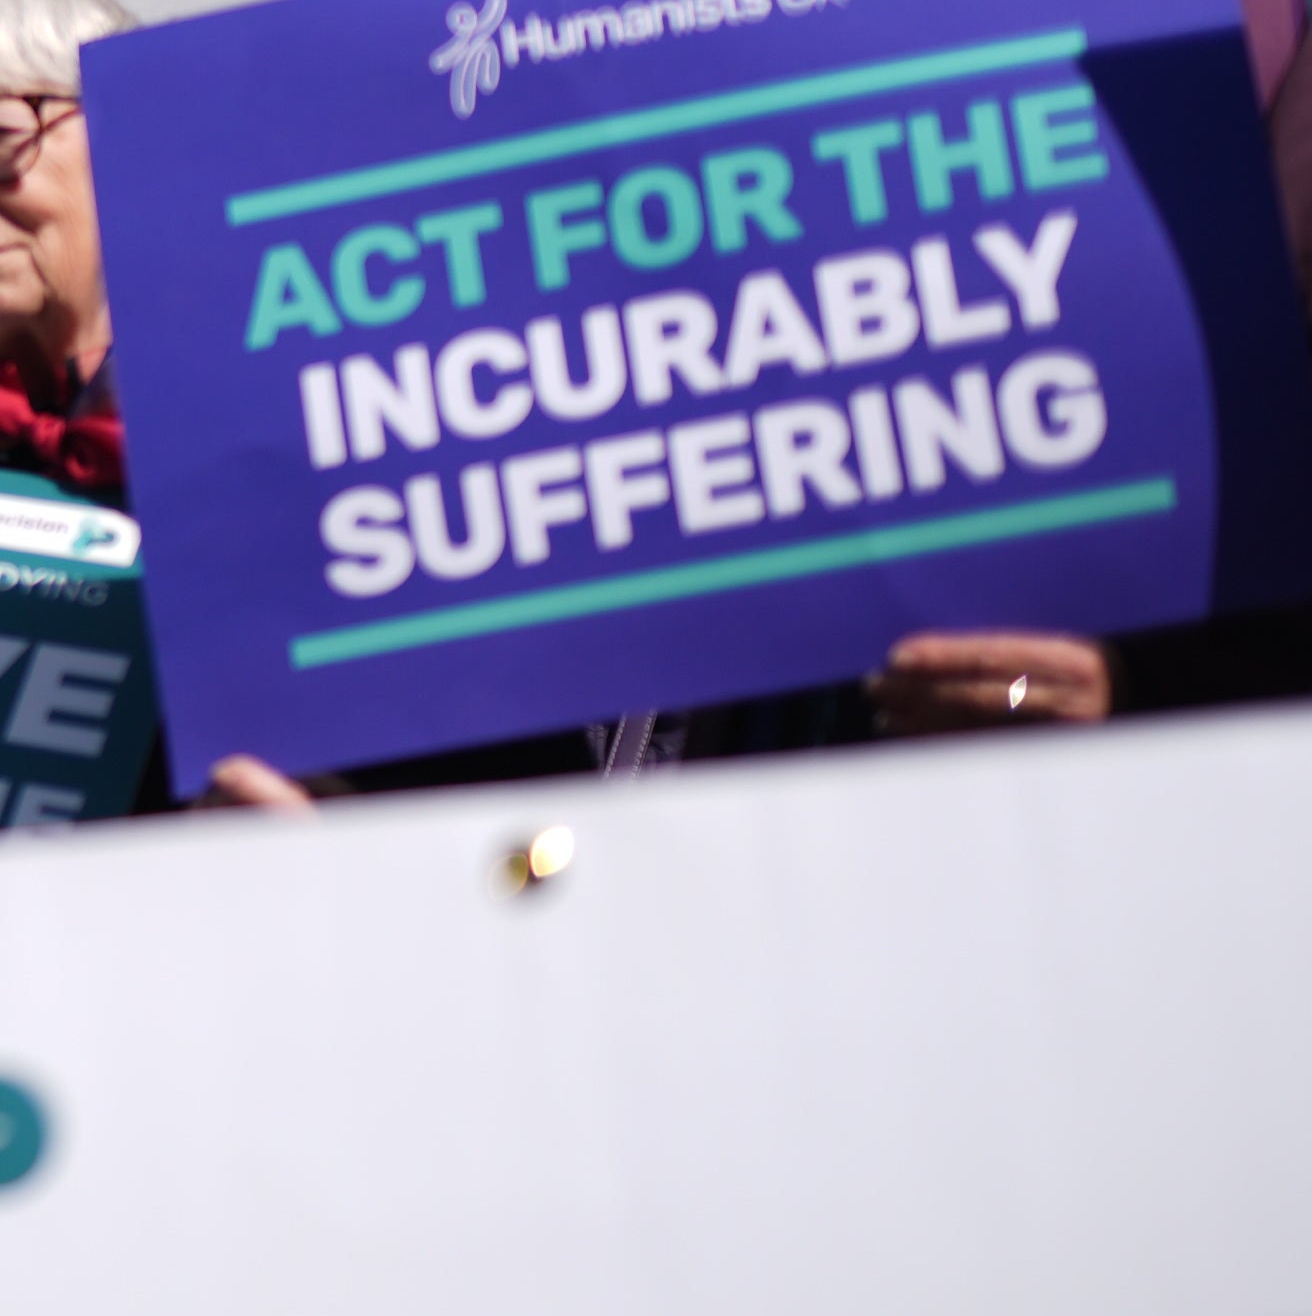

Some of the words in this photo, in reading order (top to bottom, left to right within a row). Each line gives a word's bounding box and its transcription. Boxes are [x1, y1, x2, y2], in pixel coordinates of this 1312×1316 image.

[244, 202, 502, 353] ACT
[526, 147, 802, 293] FOR
[812, 79, 1109, 228] THE
[299, 210, 1078, 470] INCURABLY
[319, 352, 1109, 597] SUFFERING
